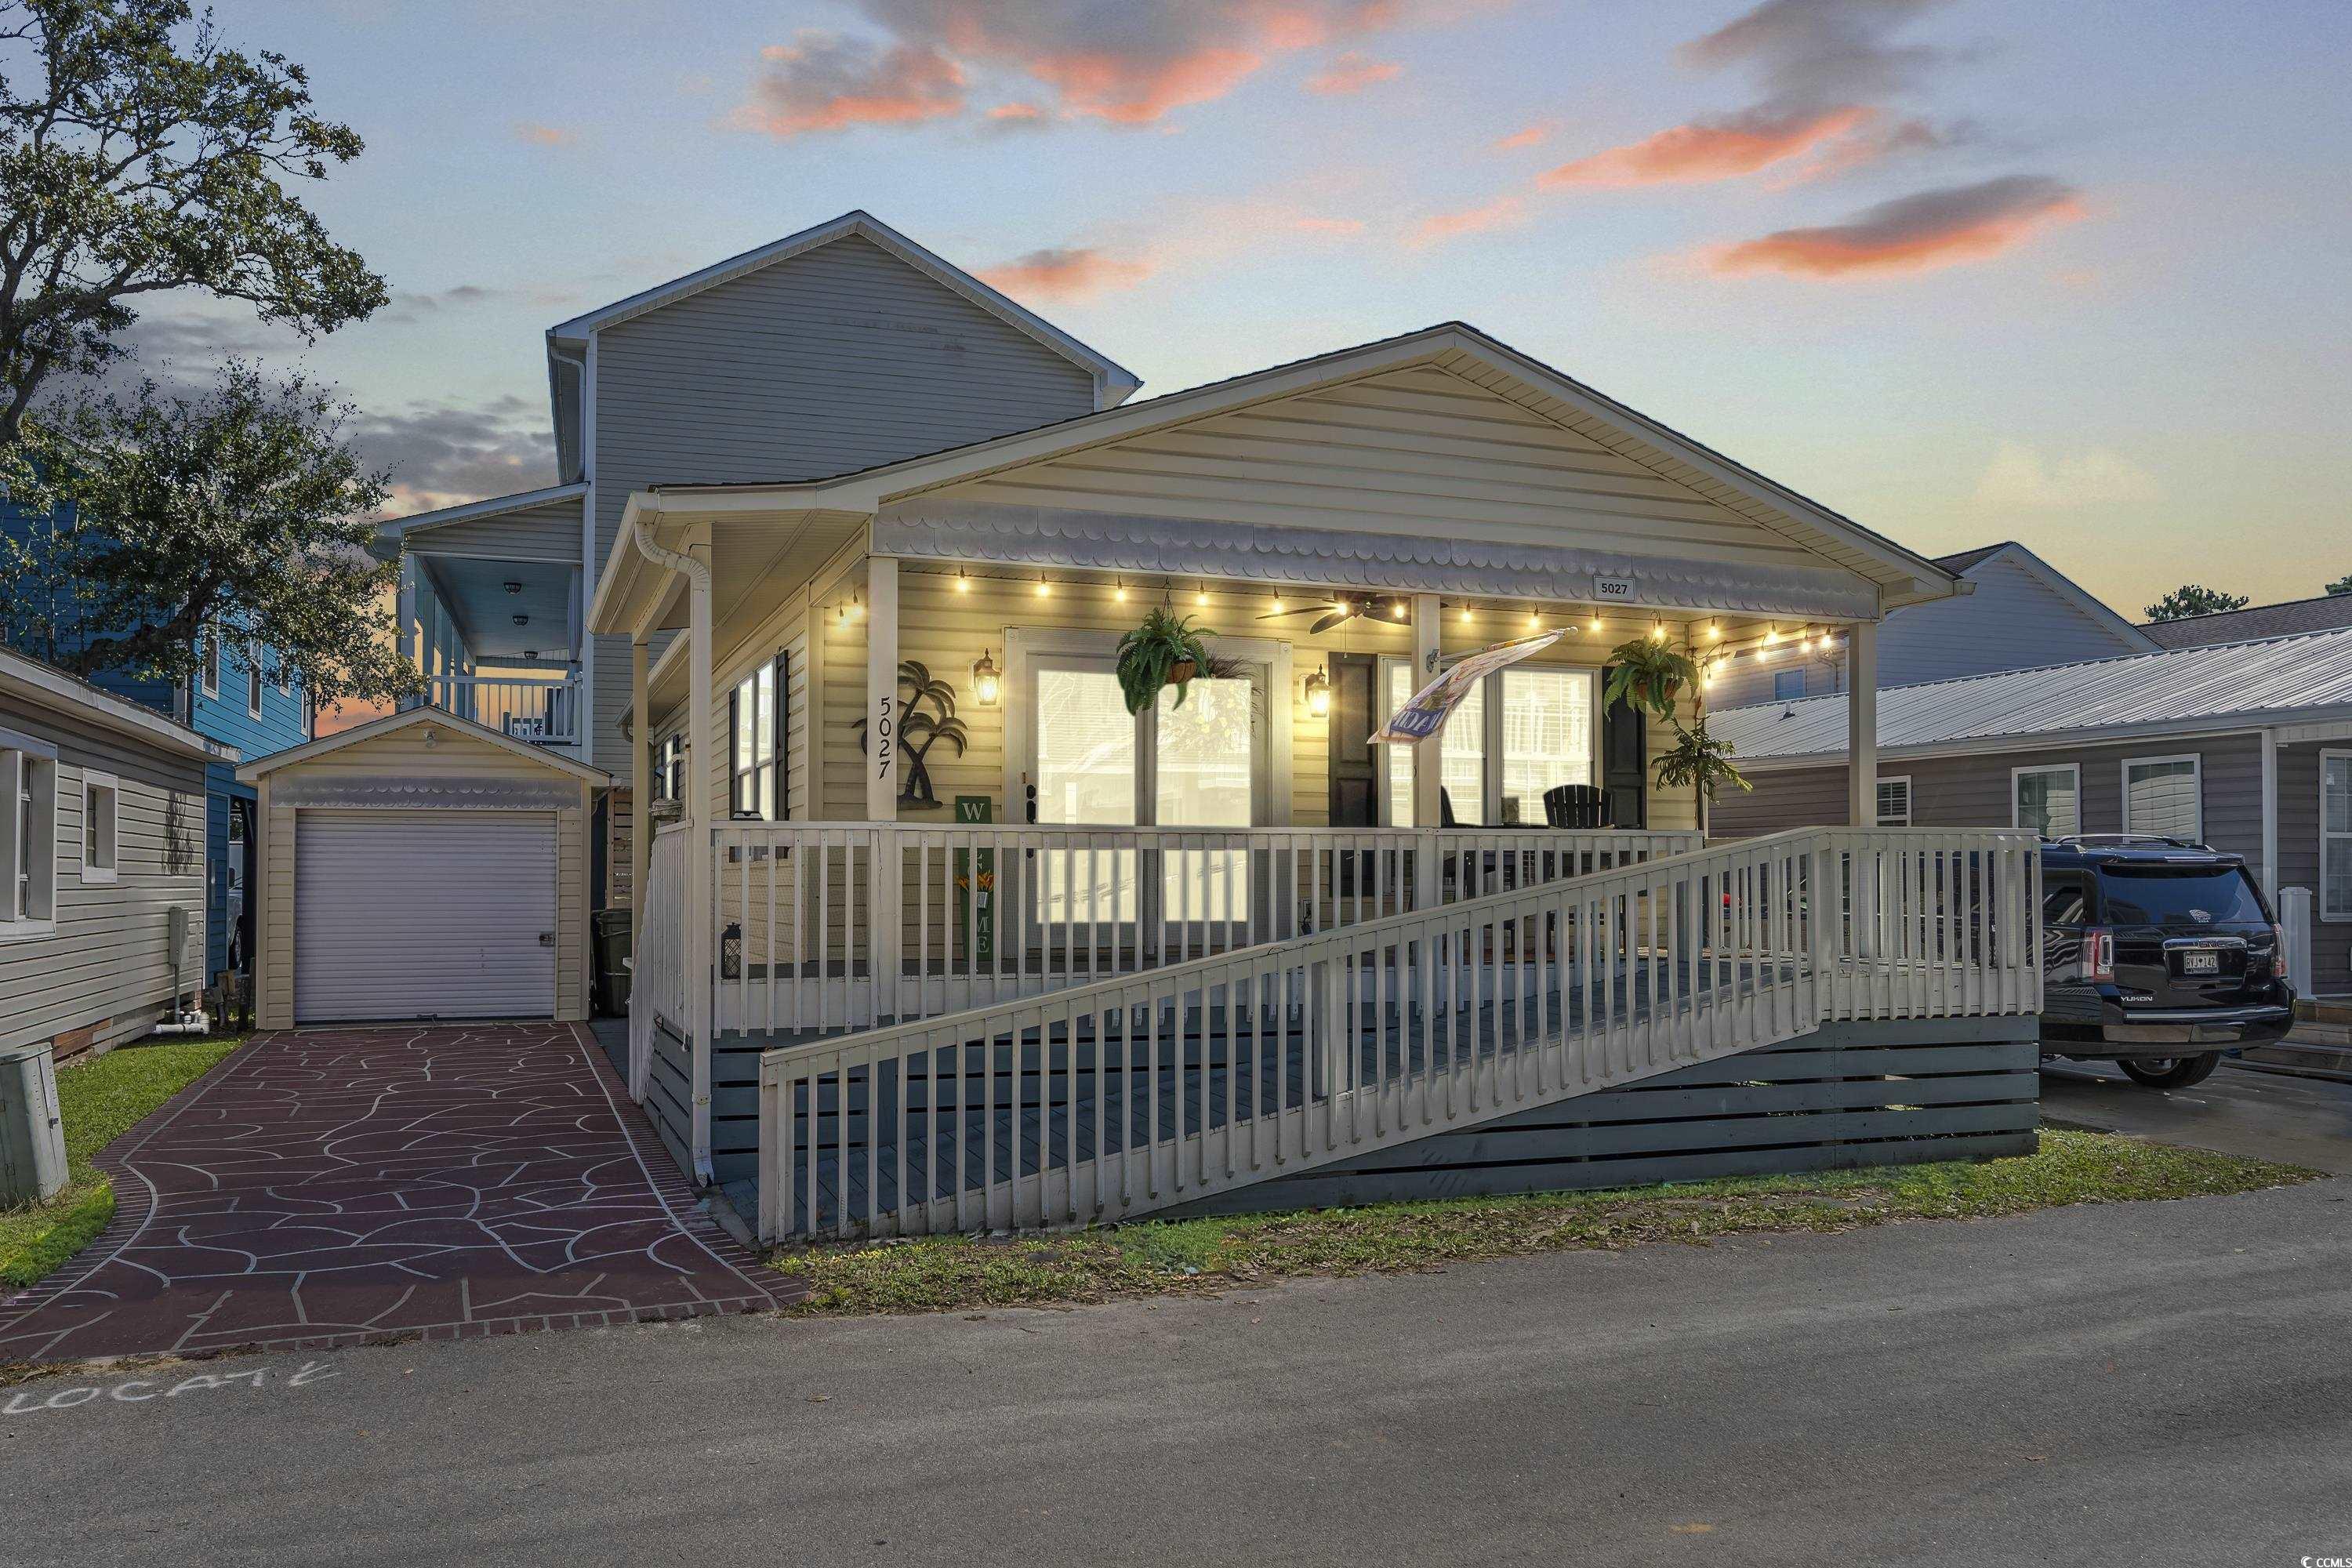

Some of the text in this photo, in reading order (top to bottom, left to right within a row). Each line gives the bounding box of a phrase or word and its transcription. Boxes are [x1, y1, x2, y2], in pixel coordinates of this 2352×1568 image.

[1601, 583, 1628, 595] 5027
[878, 696, 892, 780] 5027
[2, 1361, 342, 1414] LOCATE
